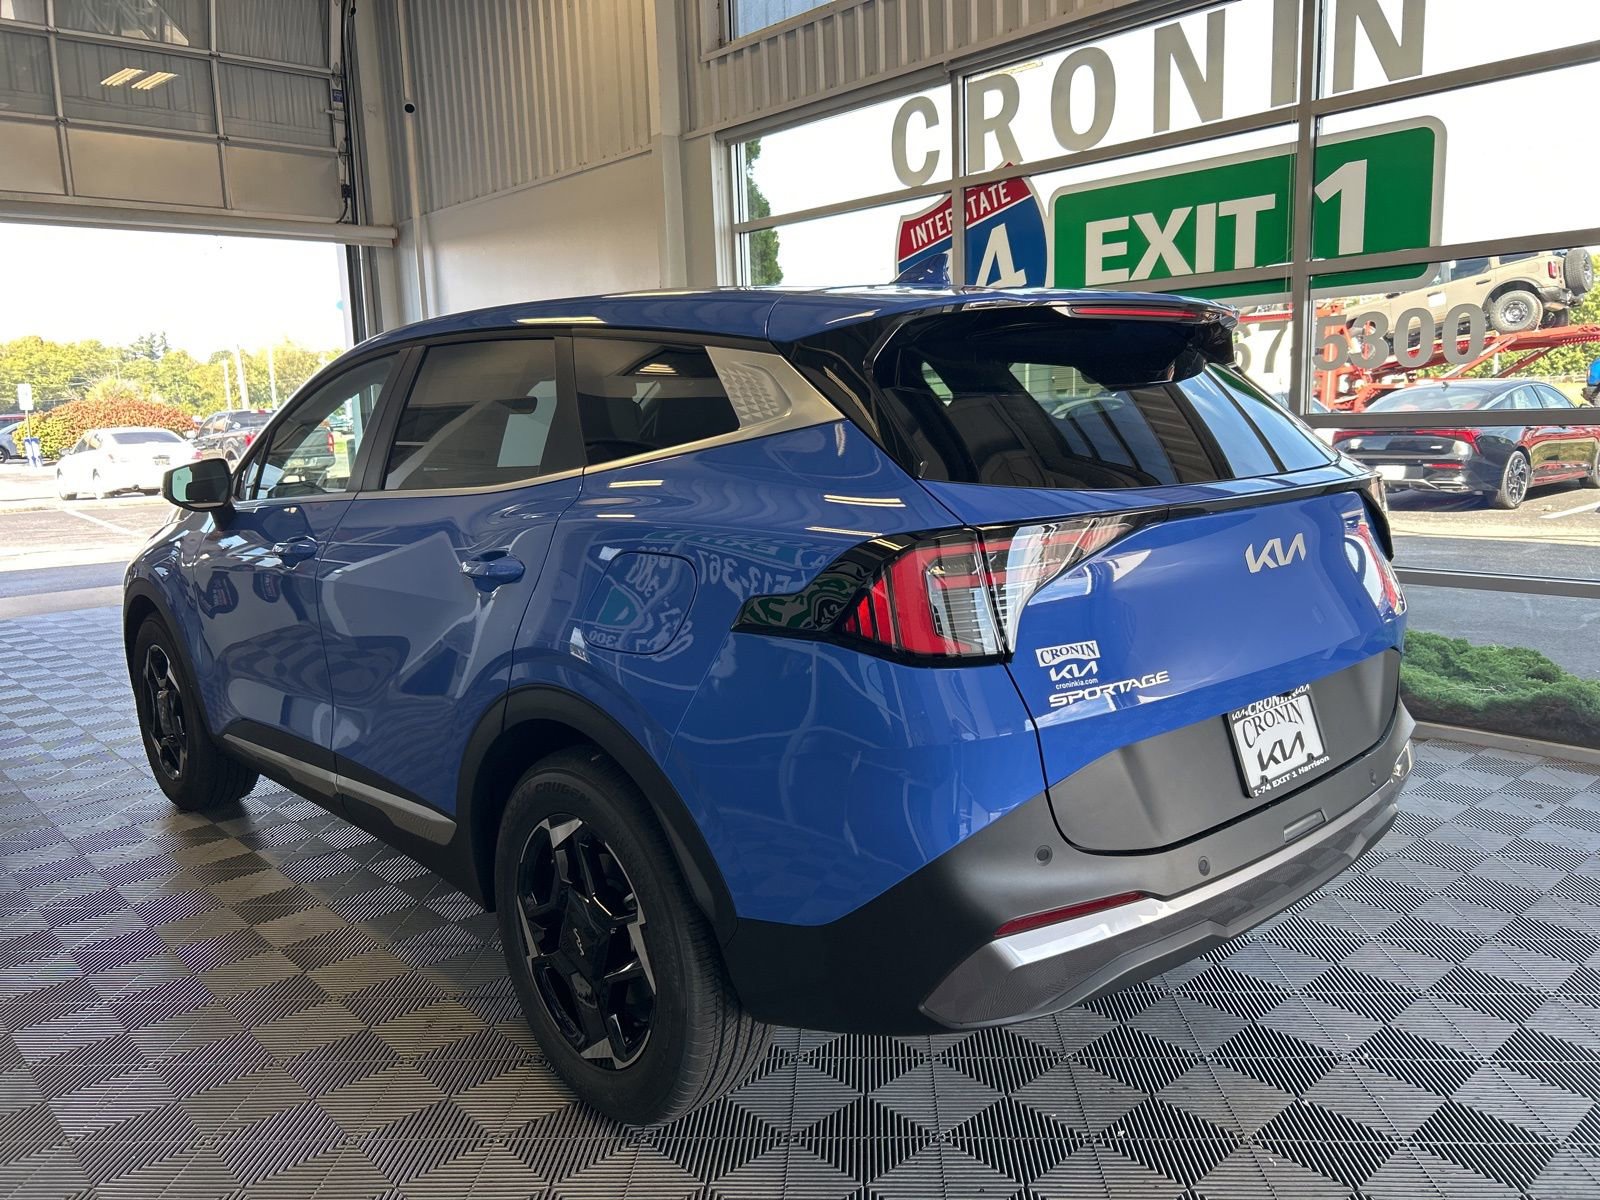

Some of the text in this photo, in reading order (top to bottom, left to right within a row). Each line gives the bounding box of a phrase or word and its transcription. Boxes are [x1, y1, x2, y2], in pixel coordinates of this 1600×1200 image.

[891, 0, 1427, 188] CRONIN
[910, 181, 1011, 249] INTERTATE
[1086, 159, 1368, 281] EXIT 1
[1312, 304, 1488, 373] 5300
[1245, 533, 1306, 573] KIA
[1040, 642, 1097, 664] CRONIN
[1049, 661, 1098, 681] KIA
[1049, 671, 1171, 707] SPORTAGE
[1055, 678, 1099, 690] croninkia.com
[1242, 700, 1304, 749] CRONIN
[1257, 730, 1306, 772] KIA
[1253, 755, 1330, 797] I-74 EXIT 1 Harrison
